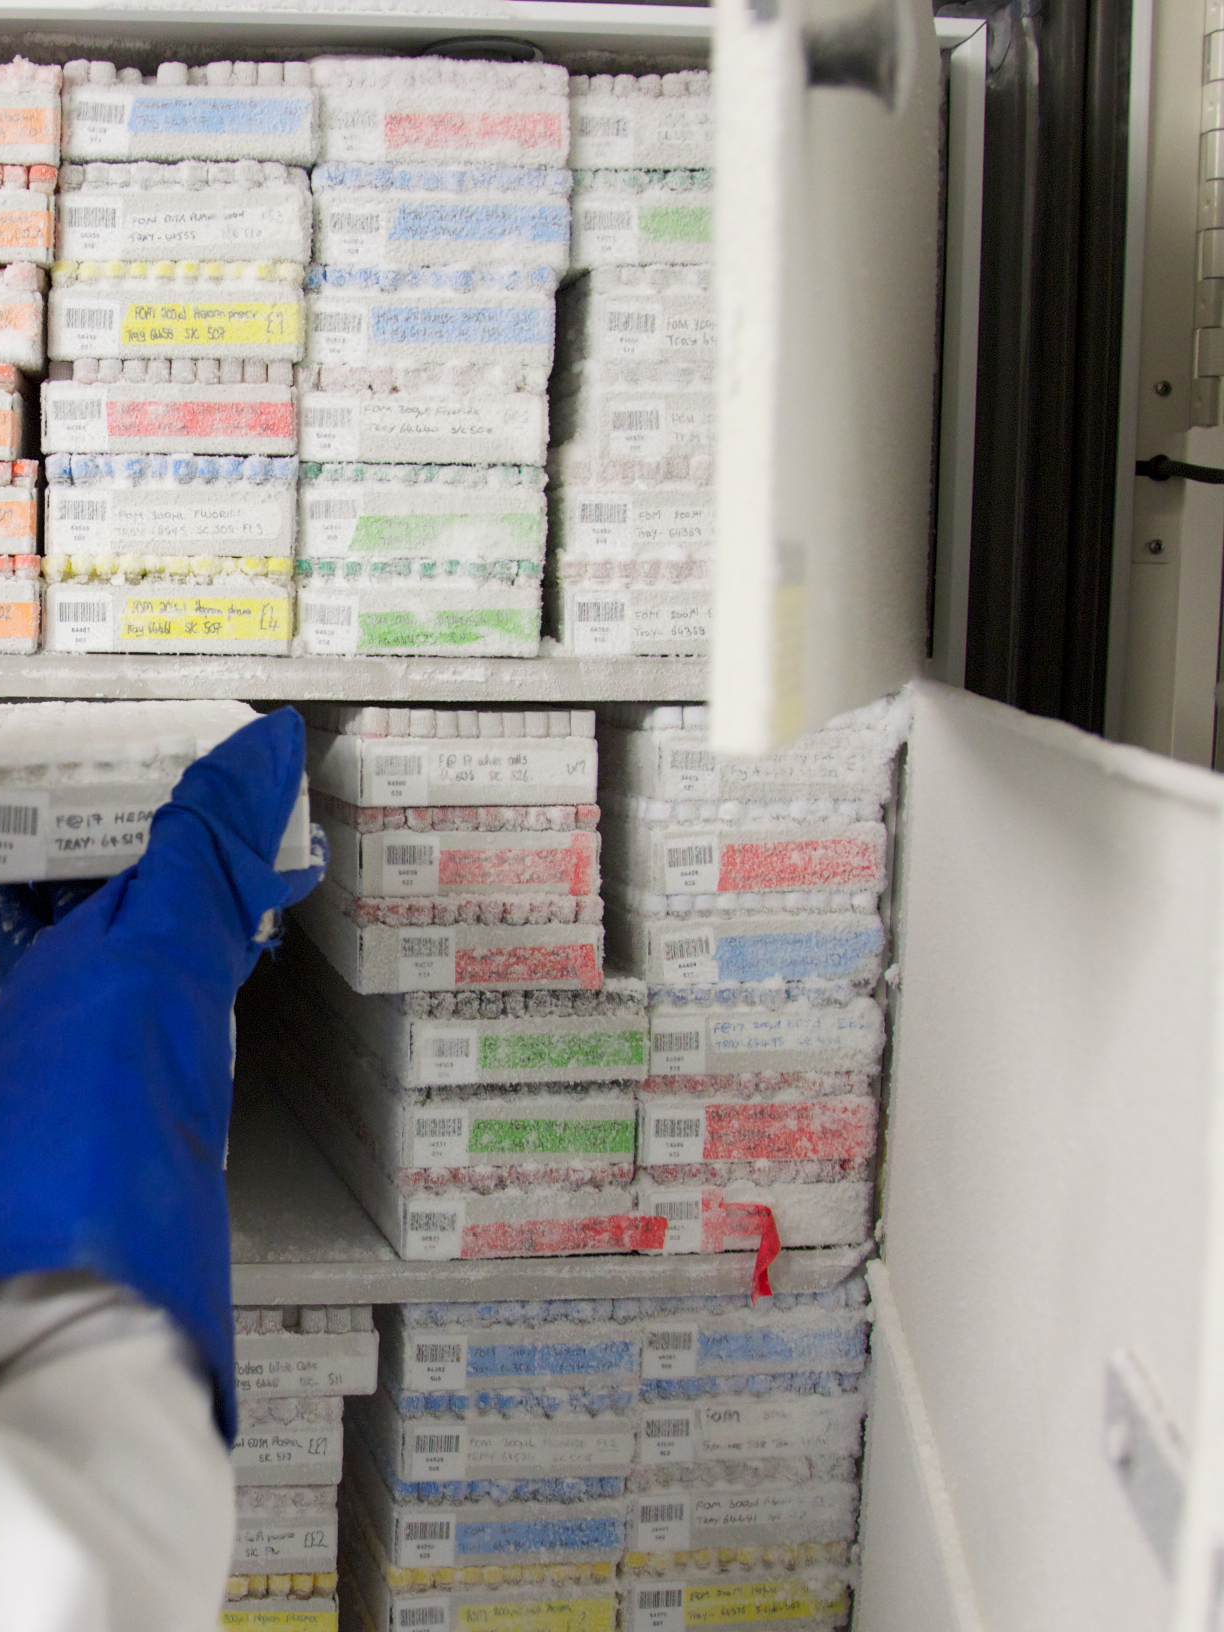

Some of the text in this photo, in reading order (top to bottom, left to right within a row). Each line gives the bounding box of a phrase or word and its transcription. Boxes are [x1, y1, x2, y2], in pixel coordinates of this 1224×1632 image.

[124, 328, 147, 343] Tray
[638, 510, 662, 522] FOM
[71, 626, 92, 634] 64461
[126, 622, 147, 639] Tray
[204, 620, 223, 637] 507
[695, 1499, 721, 1511] FOM
[285, 1612, 317, 1624] plasma
